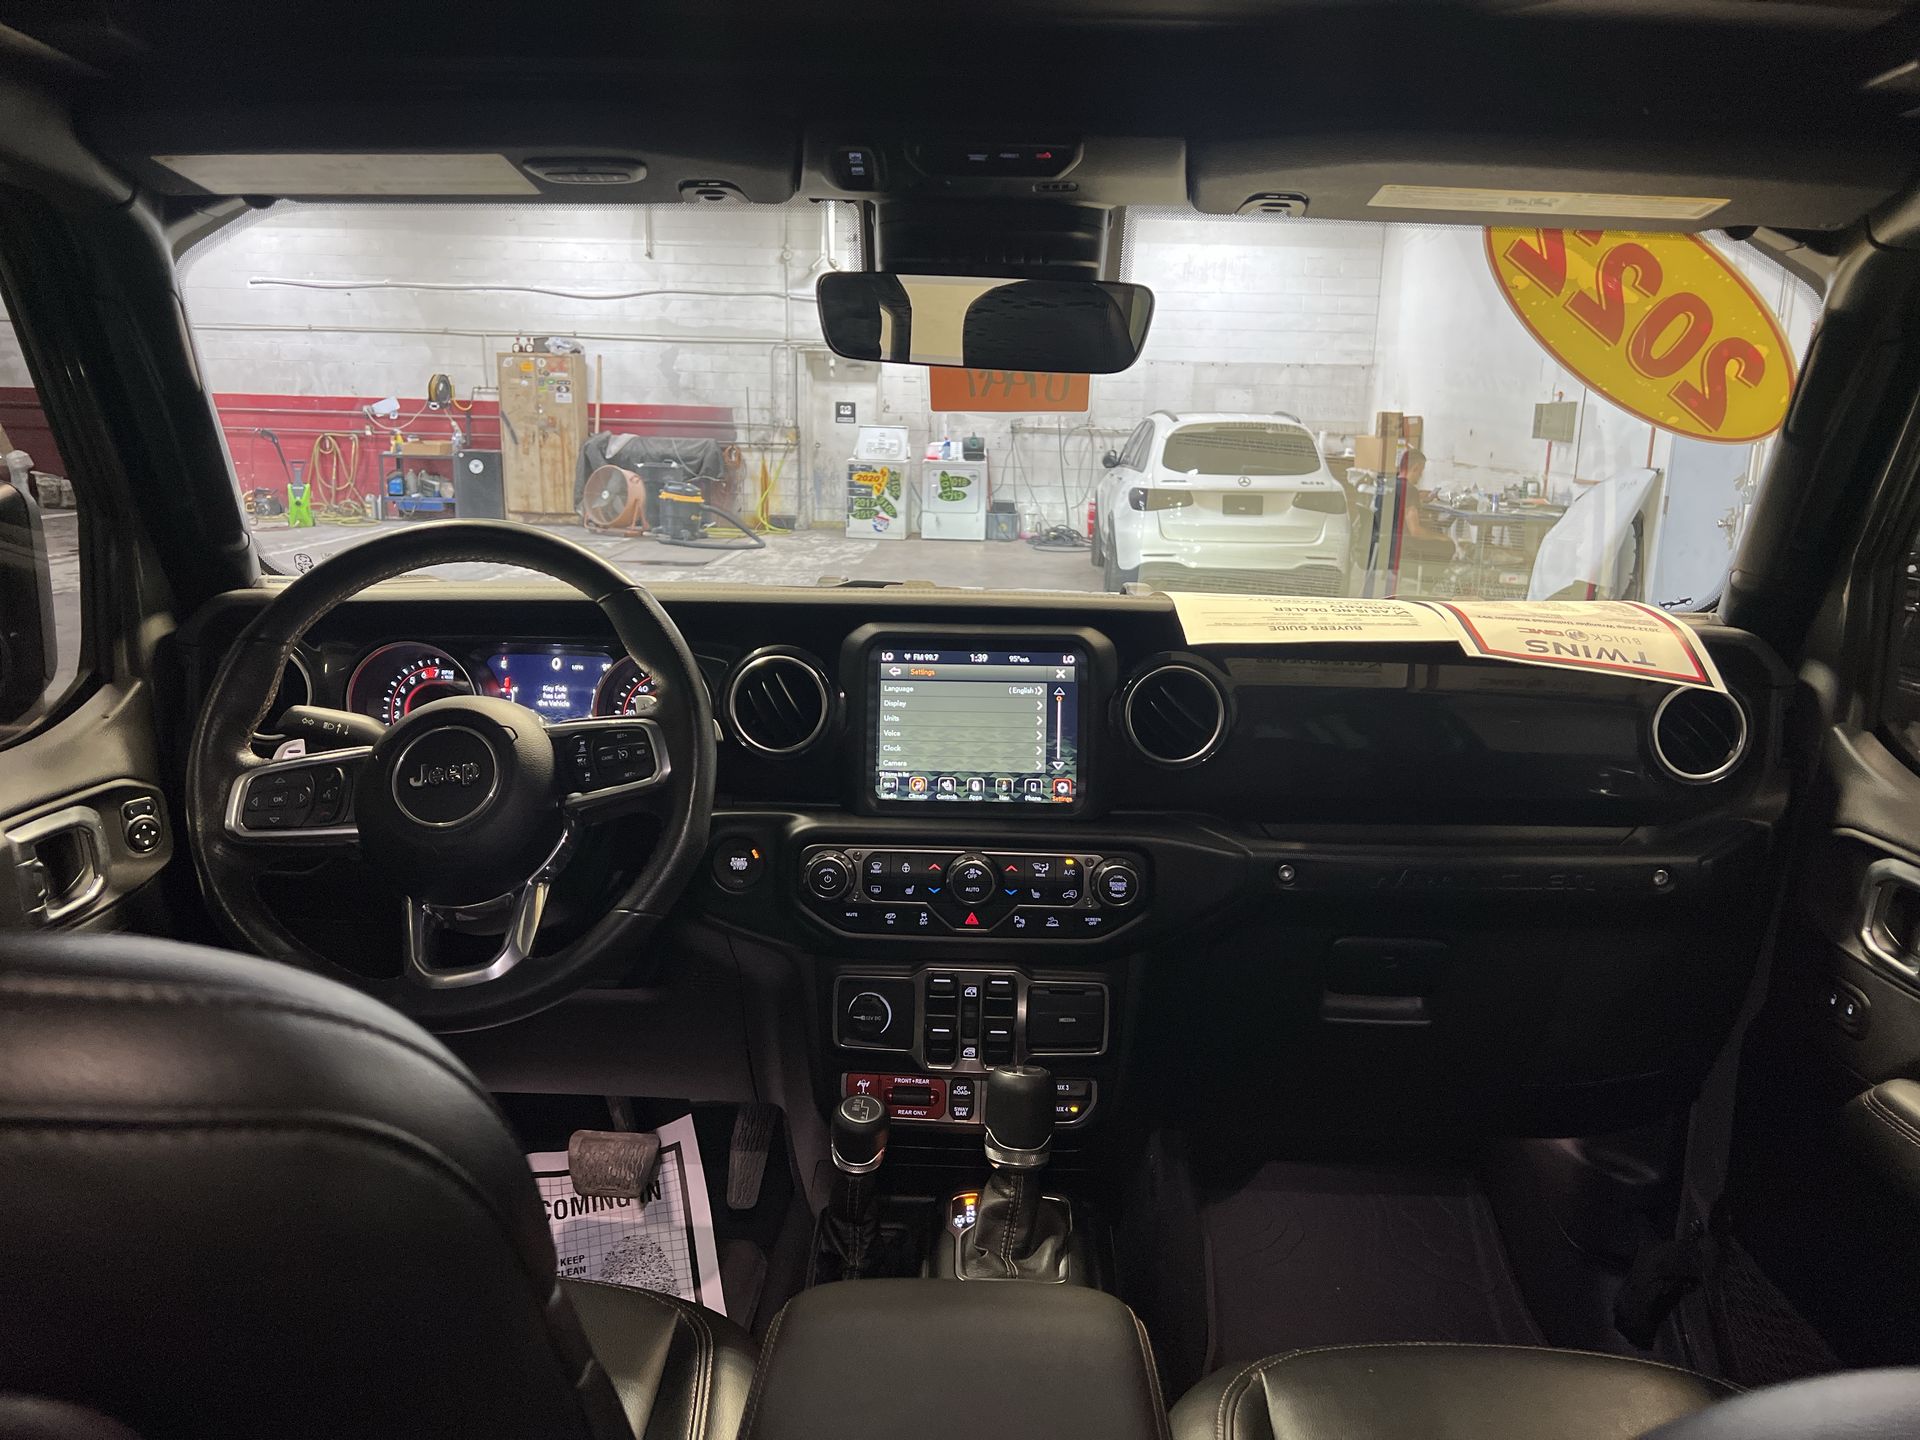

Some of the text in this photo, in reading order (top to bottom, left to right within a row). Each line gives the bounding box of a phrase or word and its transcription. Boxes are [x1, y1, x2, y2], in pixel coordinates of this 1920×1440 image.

[857, 474, 880, 483] 2020
[1516, 627, 1642, 646] BUICK GMC
[882, 652, 894, 661] LO
[970, 654, 988, 663] 1:39
[1525, 640, 1656, 667] TWINS
[1062, 655, 1075, 664] LO
[910, 668, 936, 677] Settings
[884, 685, 914, 693] Language
[884, 700, 906, 708] Display
[409, 762, 480, 788] Jeep
[560, 1255, 585, 1266] KEEP
